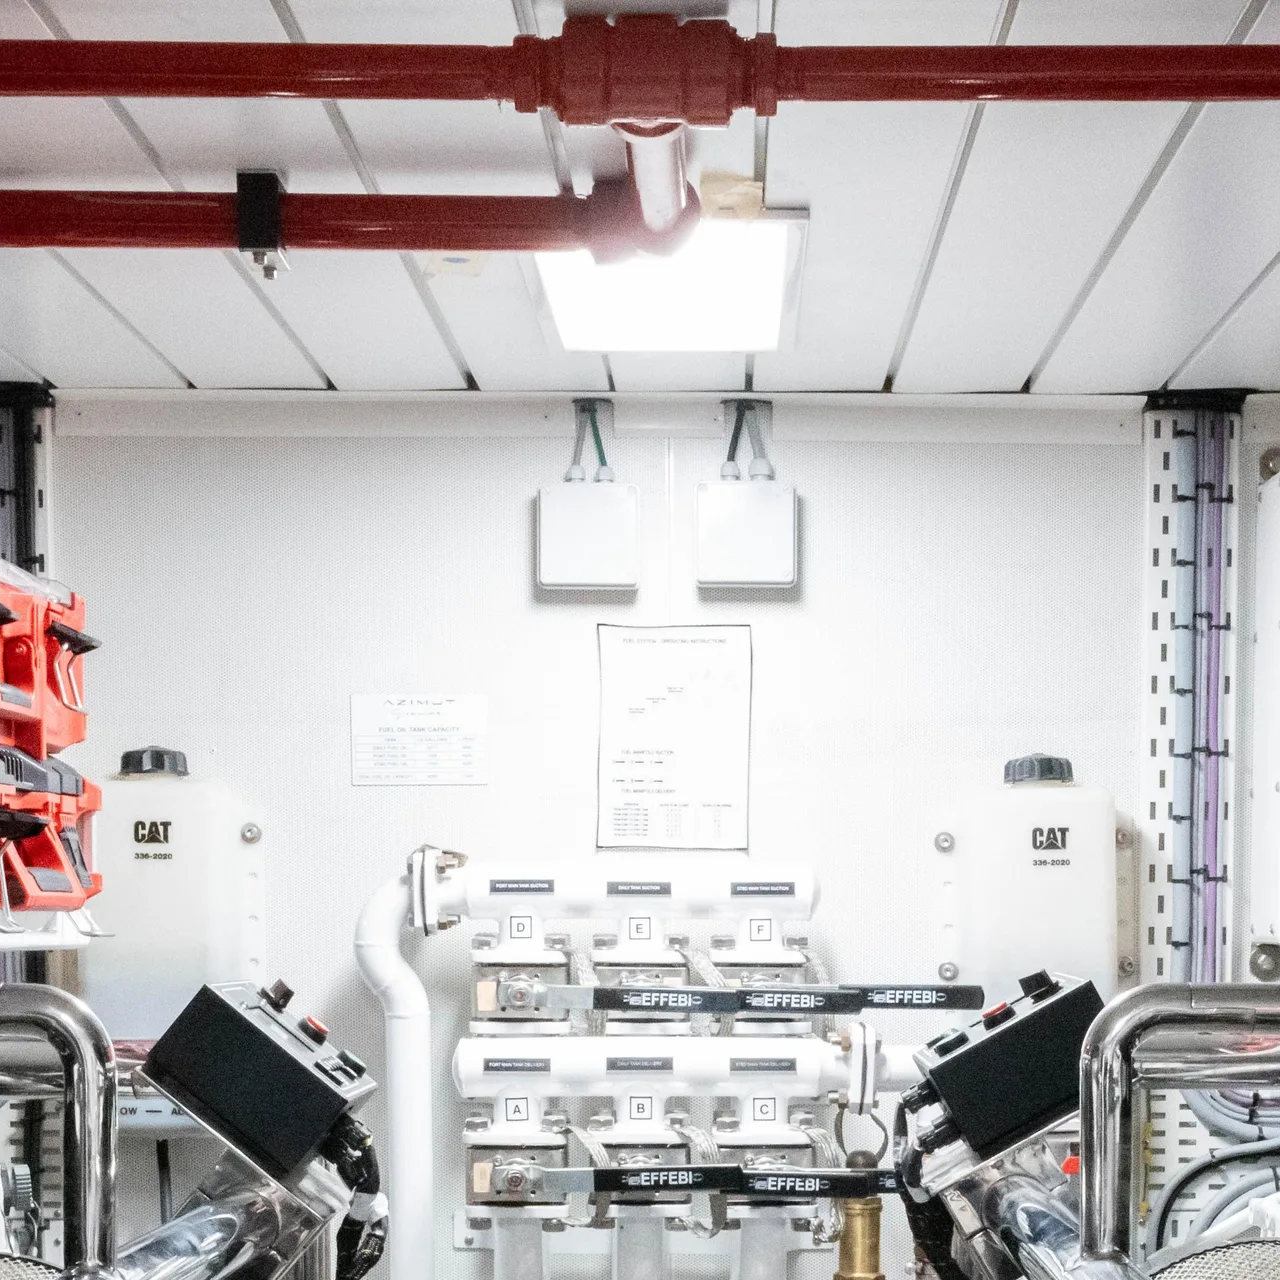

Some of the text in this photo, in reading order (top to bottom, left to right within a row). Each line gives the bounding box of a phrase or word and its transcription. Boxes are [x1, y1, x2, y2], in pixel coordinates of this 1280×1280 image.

[133, 820, 171, 845] CAT
[1032, 827, 1069, 850] CAT
[134, 852, 173, 861] 336-2020
[1032, 858, 1071, 867] 336-2020
[516, 923, 525, 932] D
[636, 924, 644, 933] E
[757, 925, 765, 935] F
[641, 993, 692, 1007] EFFEBI
[764, 993, 814, 1008] EFFEBI
[885, 990, 936, 1004] EFFEBI
[120, 1107, 138, 1115] OW
[512, 1105, 522, 1115] A
[637, 1103, 645, 1113] B
[760, 1104, 769, 1114] C
[641, 1171, 693, 1185] EFFEBI
[768, 1177, 820, 1191] EFFEBI
